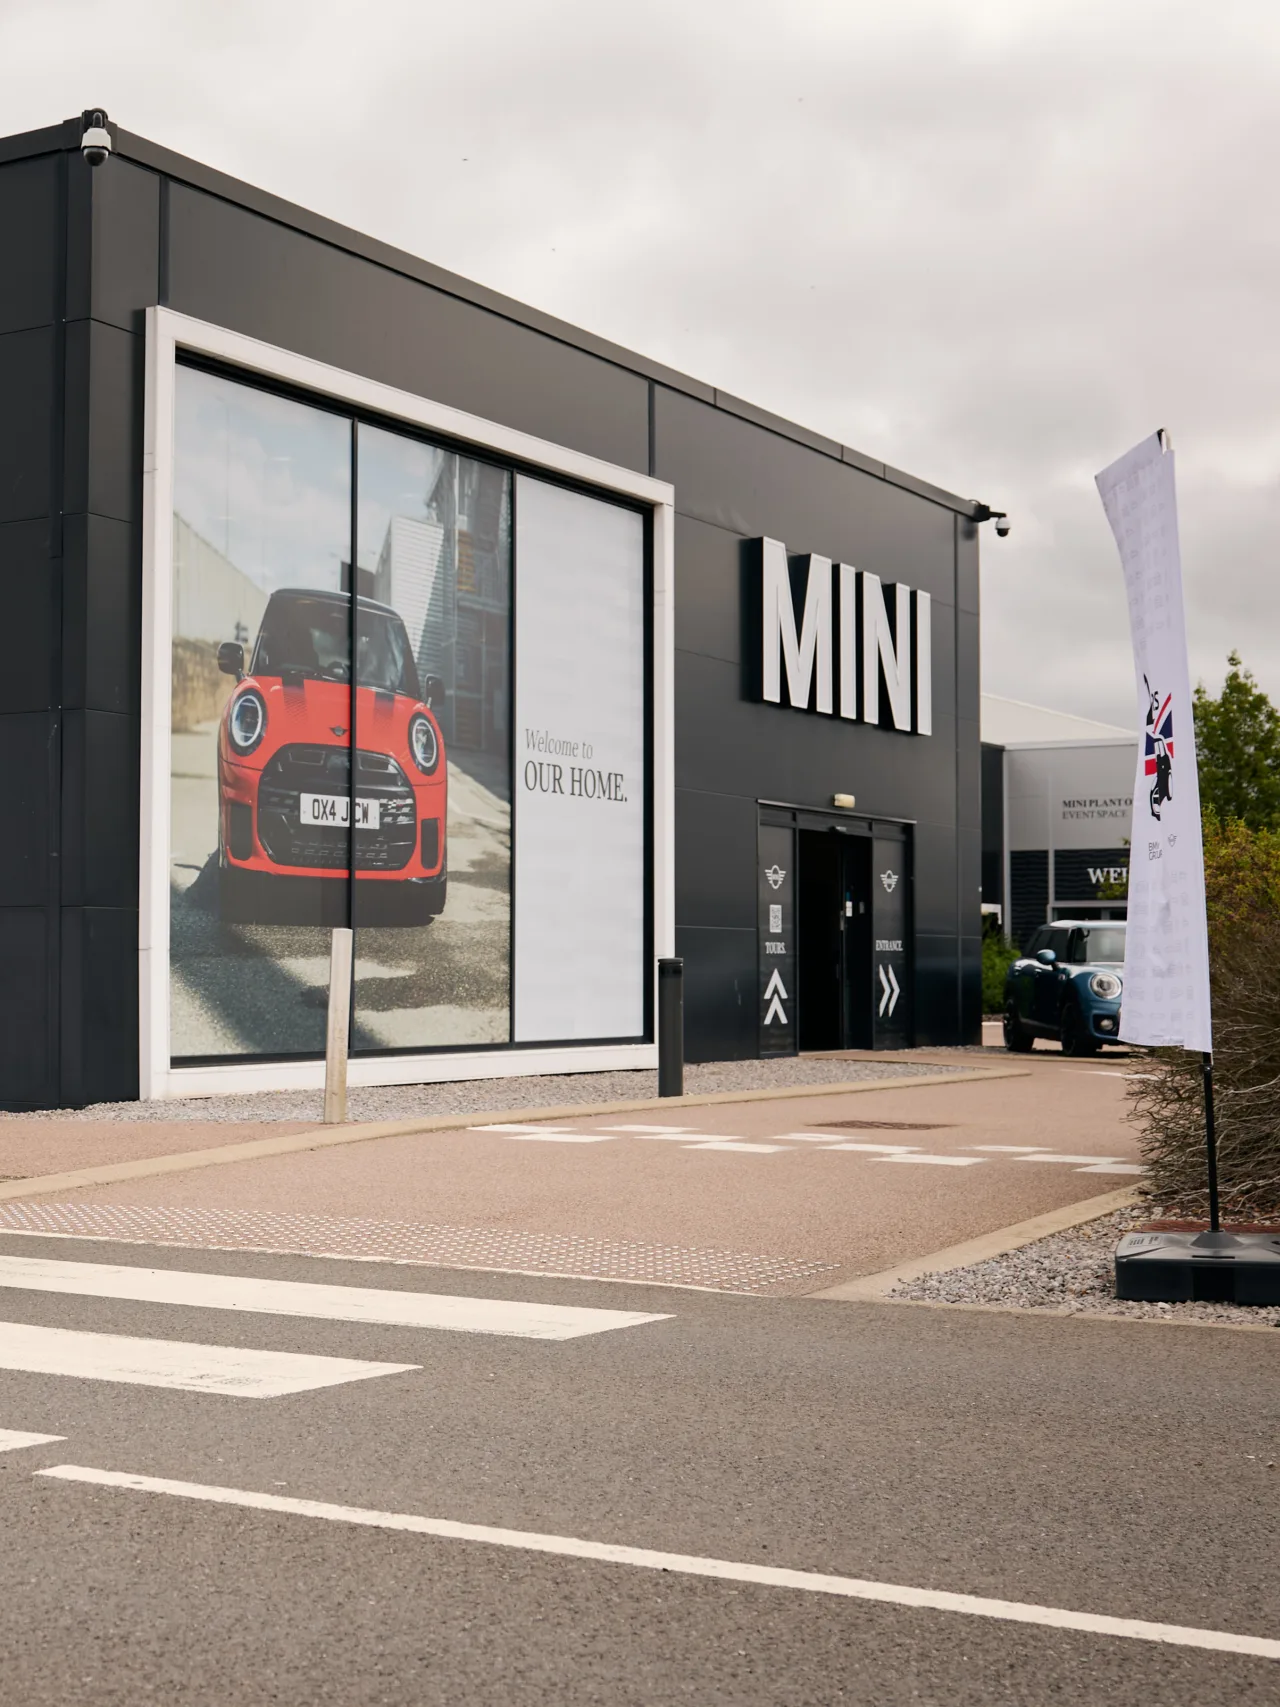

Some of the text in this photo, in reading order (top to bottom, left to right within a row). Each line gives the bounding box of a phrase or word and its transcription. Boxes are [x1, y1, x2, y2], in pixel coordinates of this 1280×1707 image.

[763, 536, 932, 736] MINI
[525, 728, 593, 760] Welcome to
[524, 760, 628, 803] OUR HOME.
[1062, 797, 1133, 808] MINI PLANT O
[1062, 809, 1128, 820] EVENT SPACE
